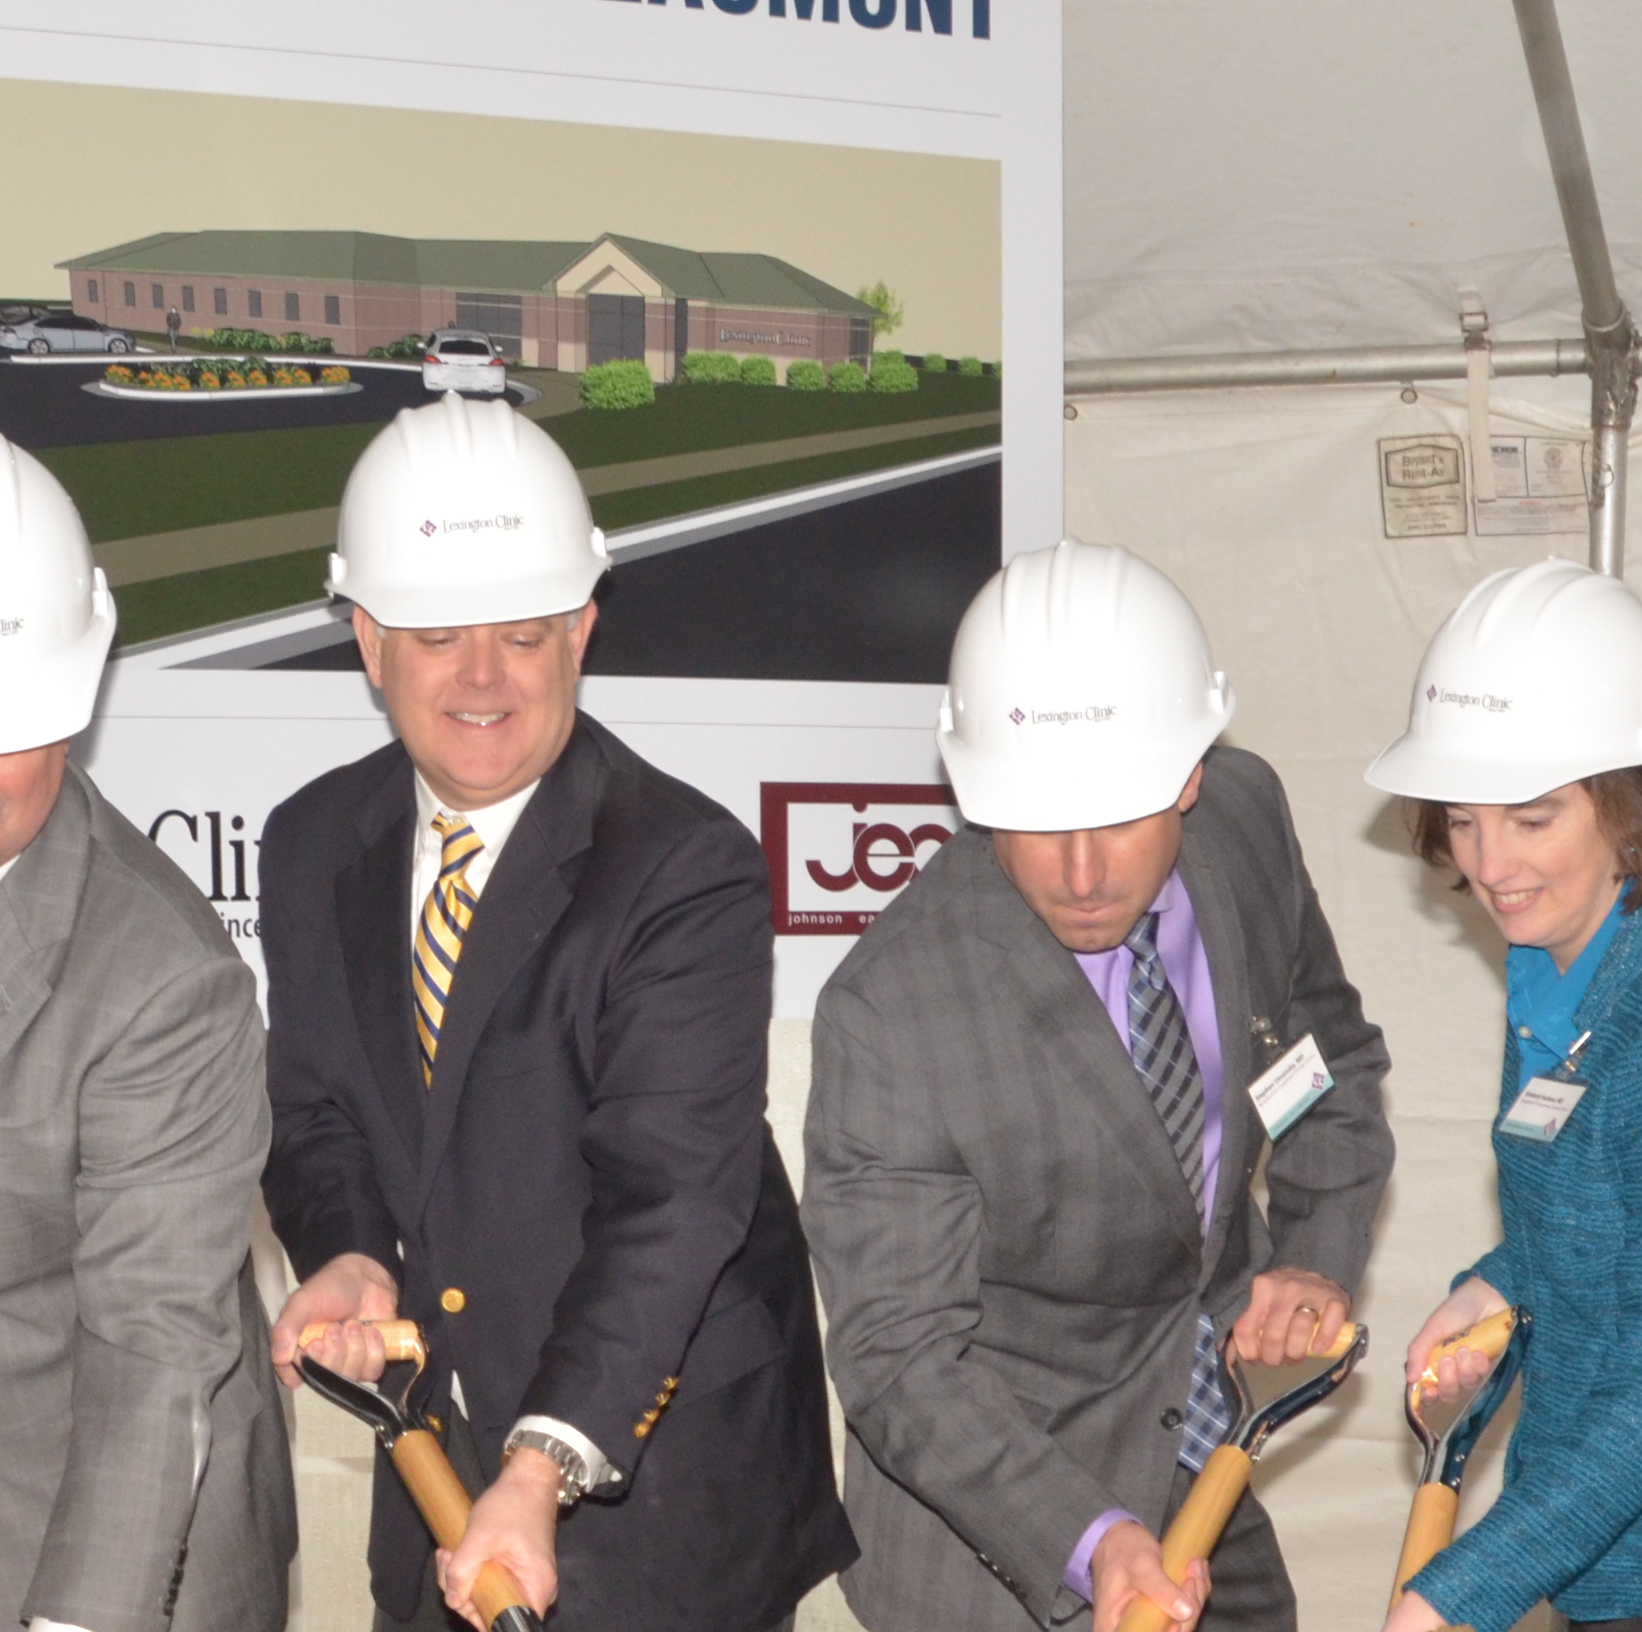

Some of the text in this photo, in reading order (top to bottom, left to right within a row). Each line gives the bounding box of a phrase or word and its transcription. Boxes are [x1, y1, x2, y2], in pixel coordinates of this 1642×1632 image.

[442, 514, 525, 533] Lexington Clinic
[1439, 688, 1513, 711] Lexington Clinic
[1031, 704, 1117, 726] Lexington Clinic
[788, 911, 843, 927] johnson
